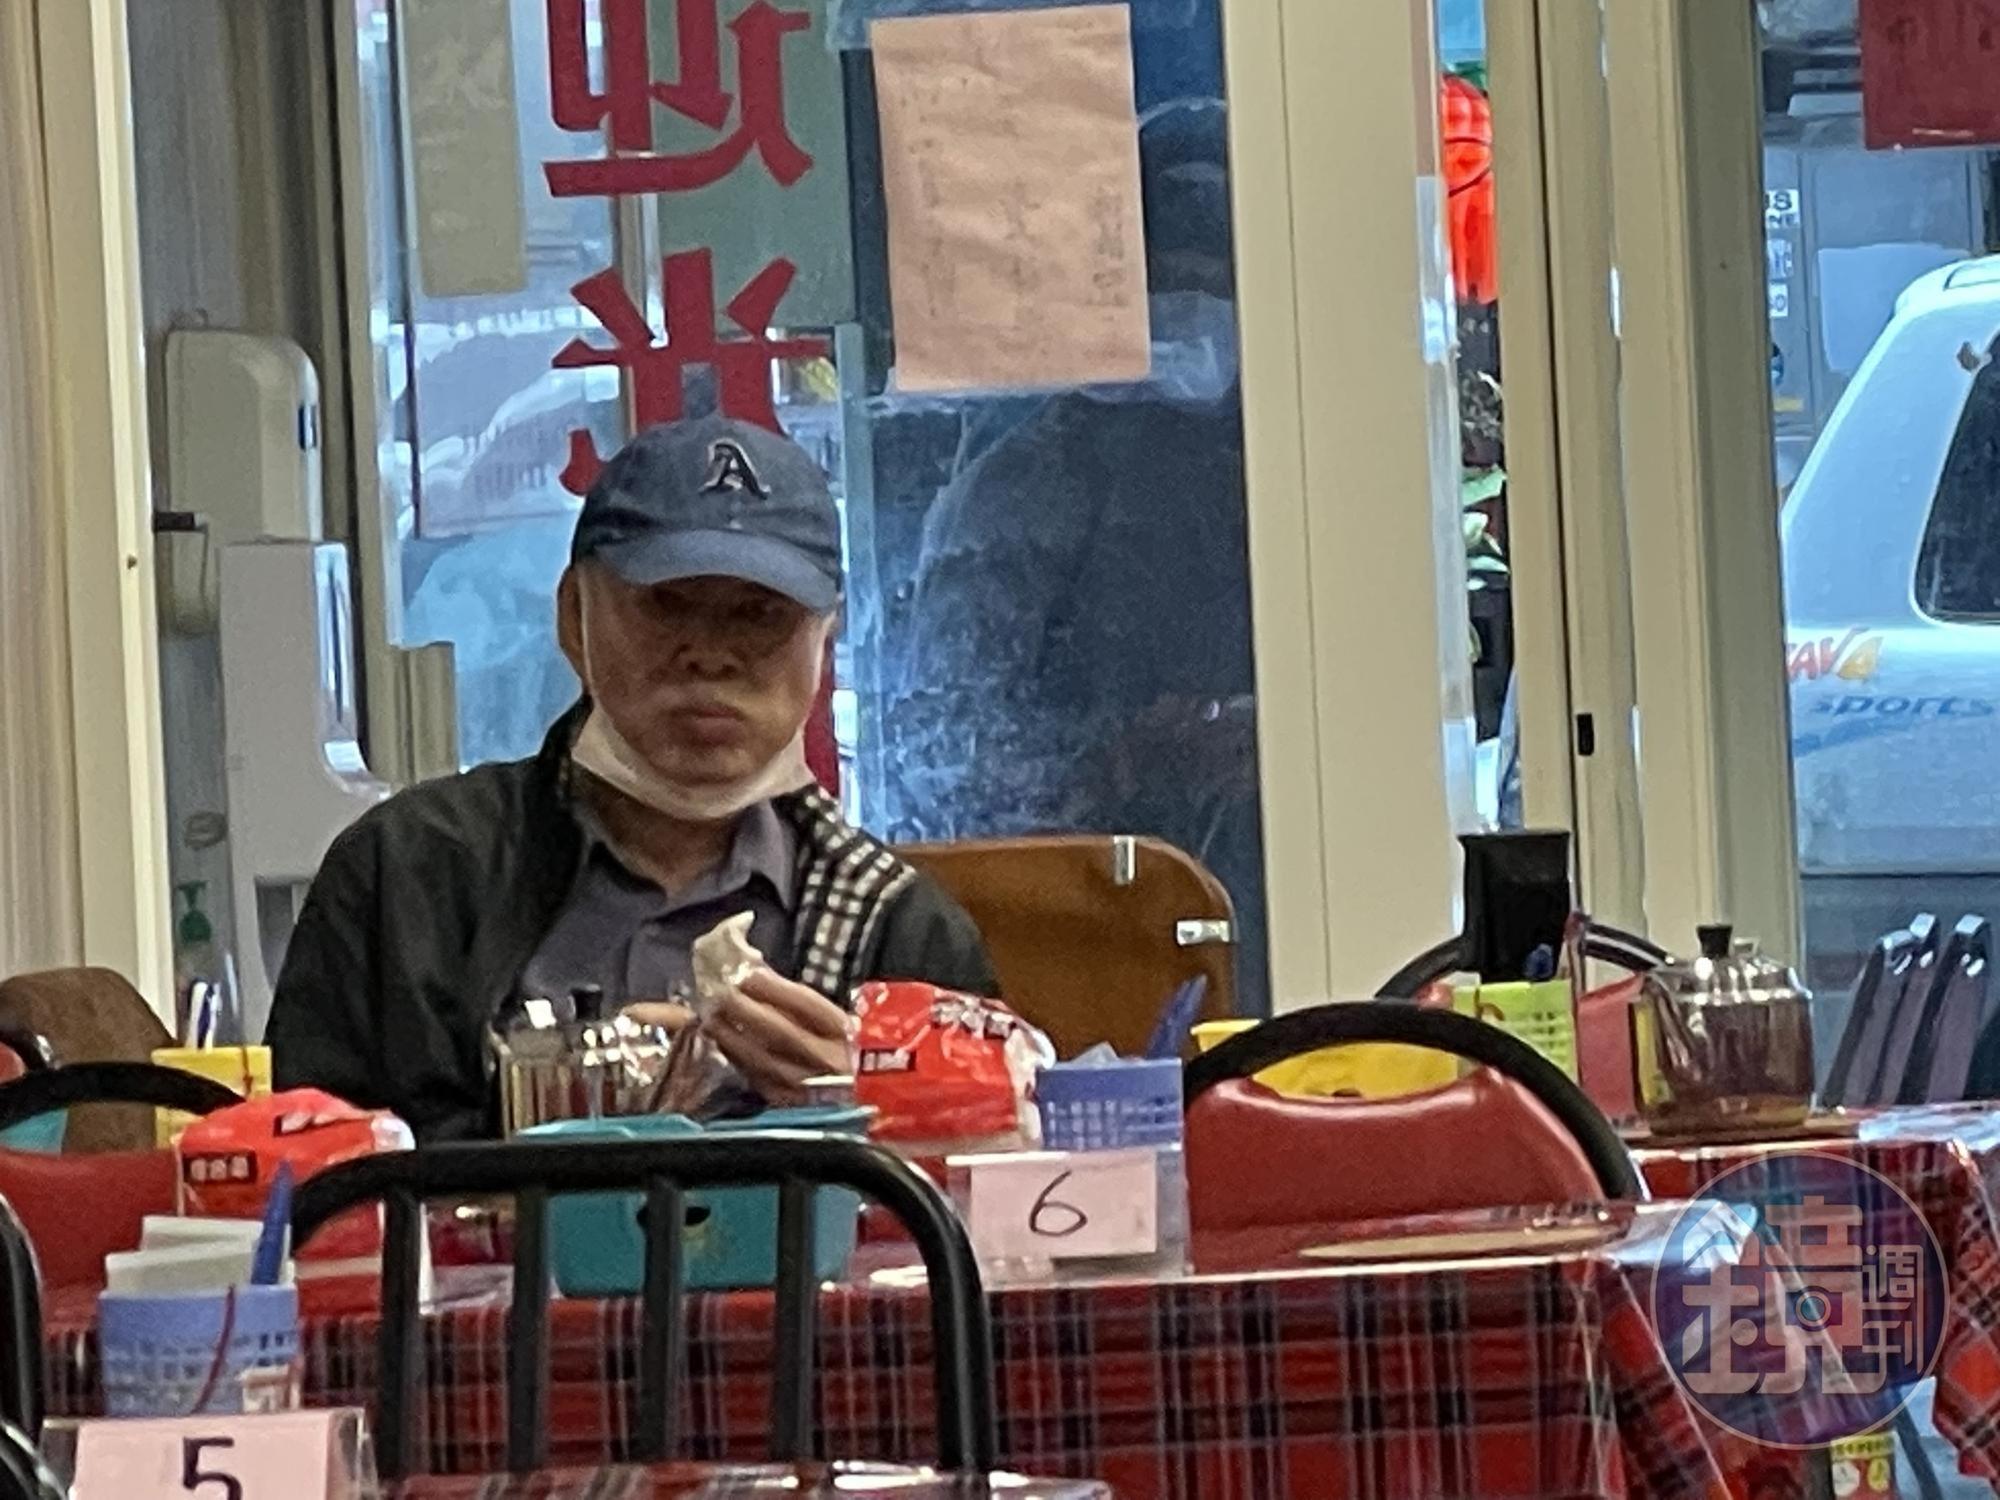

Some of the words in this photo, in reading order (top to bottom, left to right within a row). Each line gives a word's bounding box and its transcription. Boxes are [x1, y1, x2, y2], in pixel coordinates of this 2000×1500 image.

[700, 437, 771, 500] A
[1028, 1170, 1088, 1236] 6
[182, 1436, 243, 1500] 5
